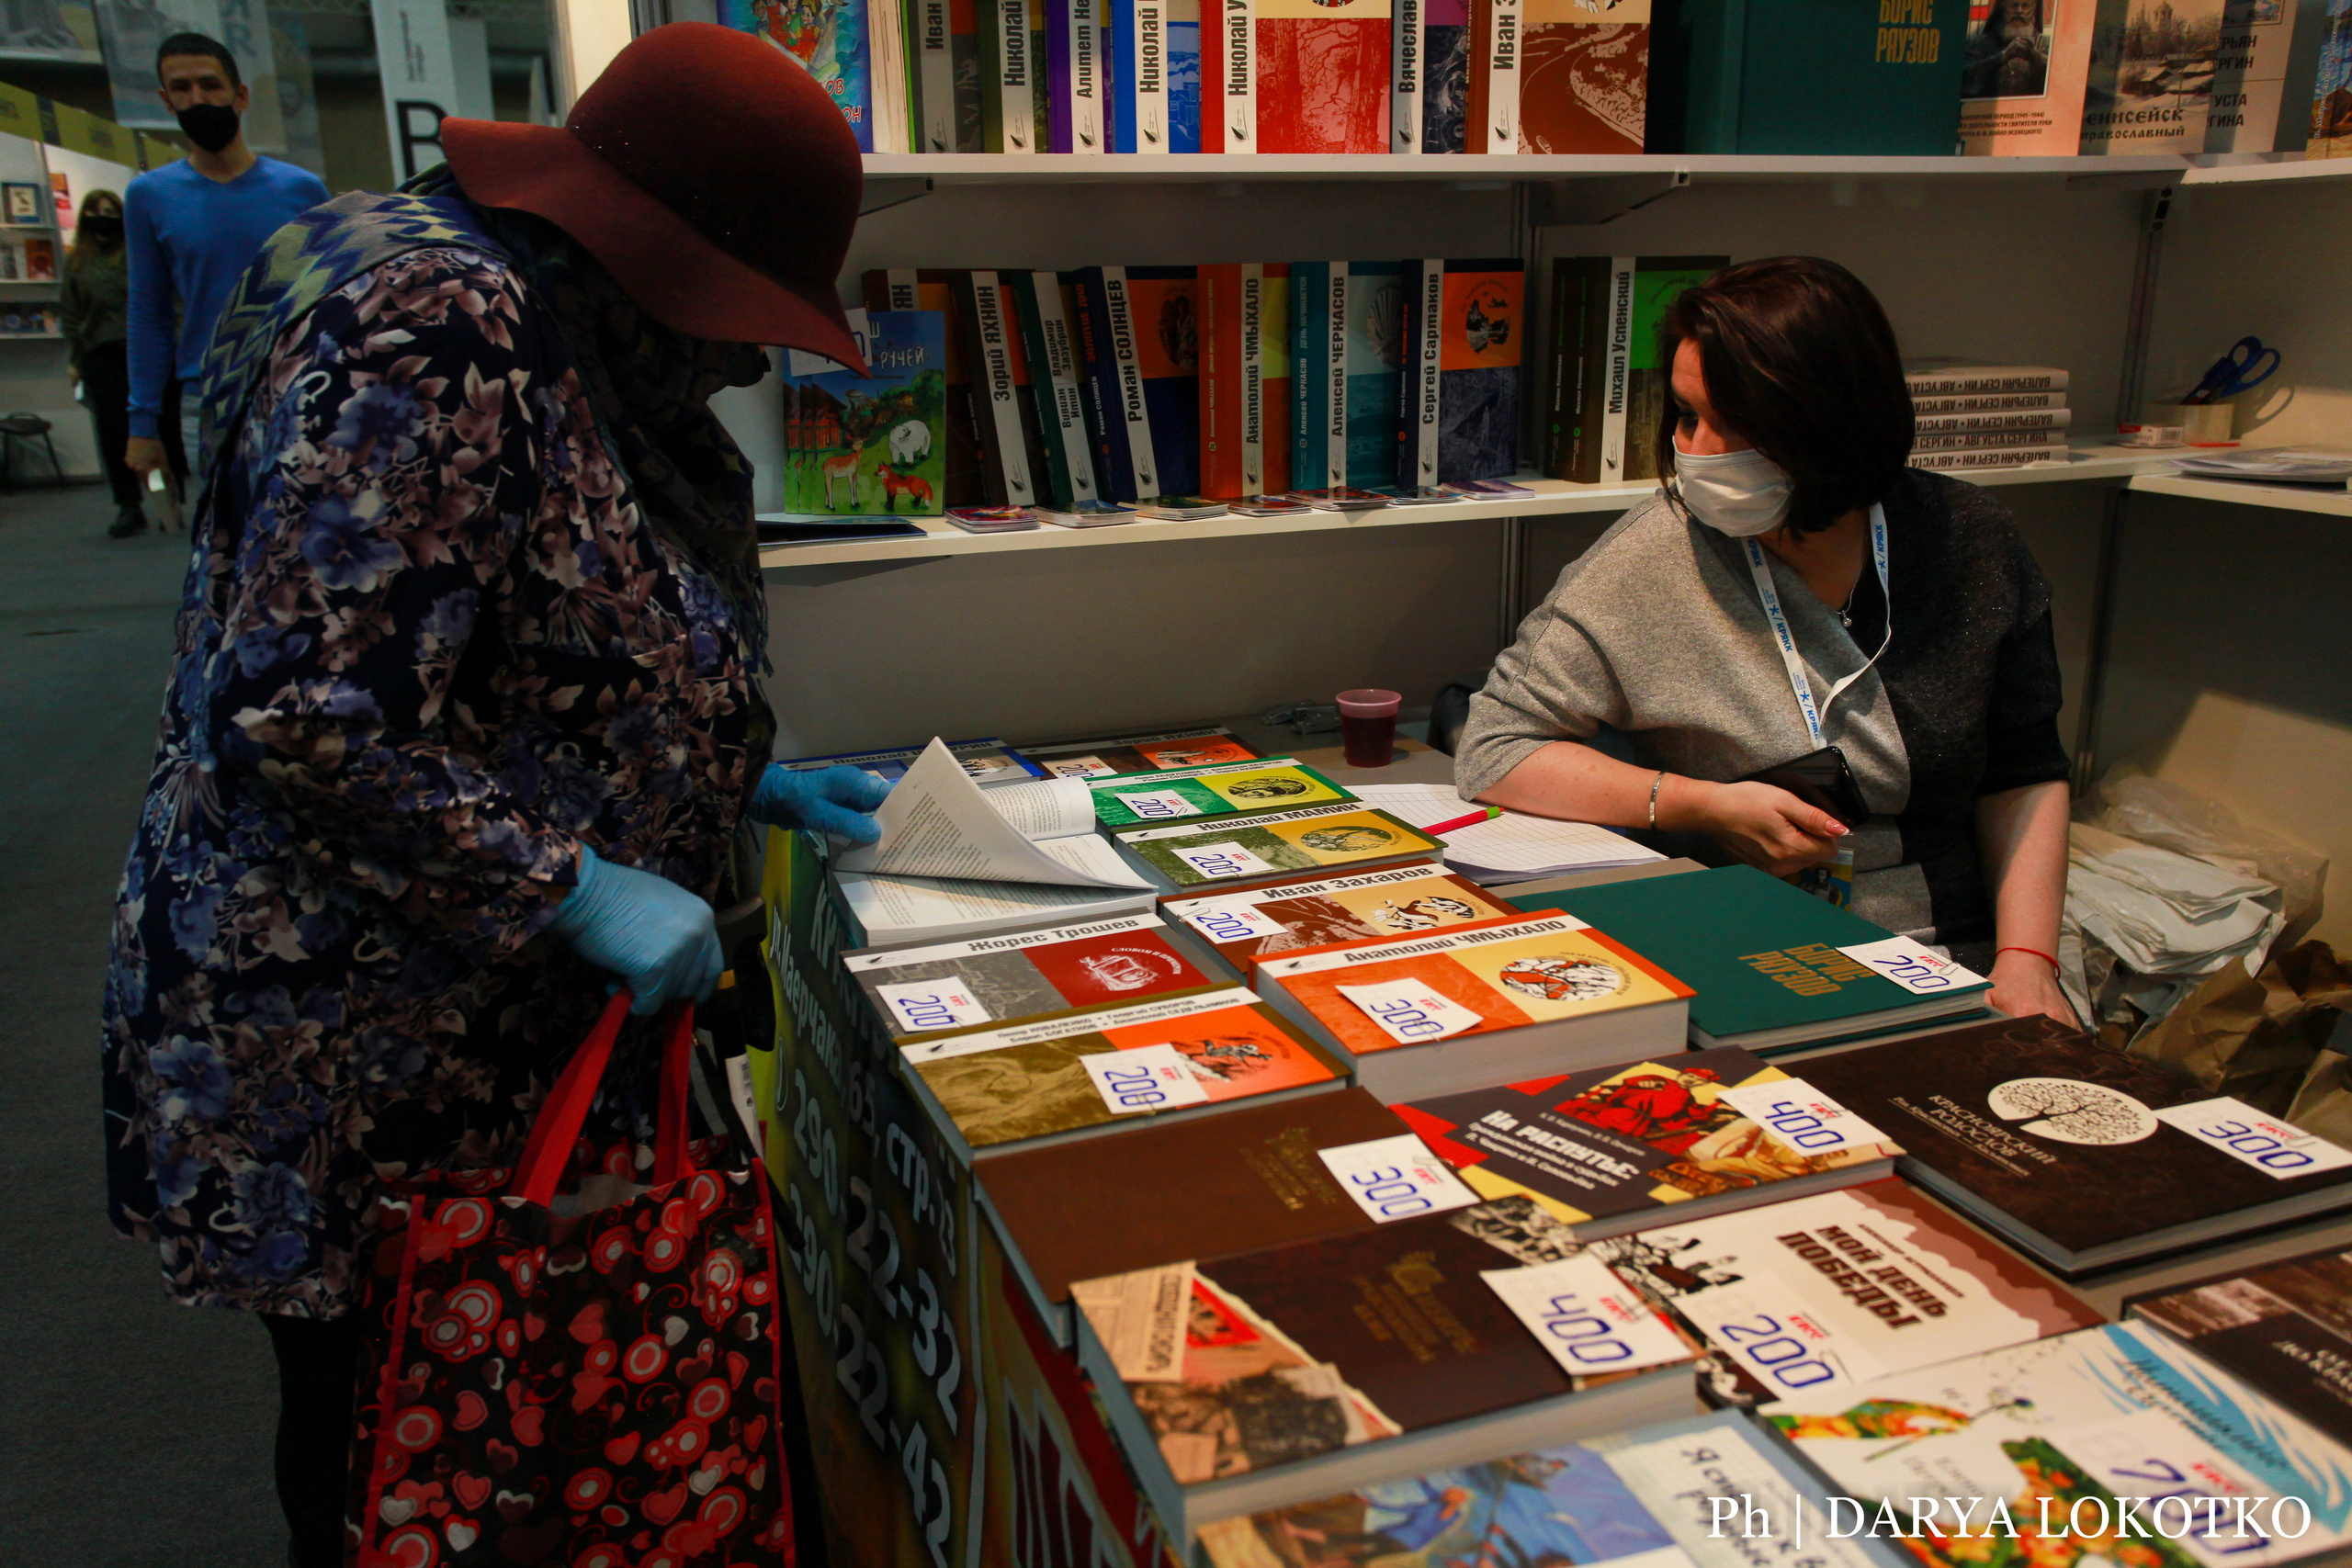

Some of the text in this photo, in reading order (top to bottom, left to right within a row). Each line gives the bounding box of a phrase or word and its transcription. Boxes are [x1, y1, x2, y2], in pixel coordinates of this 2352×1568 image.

[926, 3, 944, 50] Иван
[1001, 0, 1025, 86] Николай
[1397, 0, 1417, 93] Вячеслав
[1492, 14, 1516, 70] Иван
[1876, 28, 1939, 64] РЯУЗОВ
[1076, 25, 1092, 98] Алитет
[1138, 8, 1159, 93] Николай
[1227, 17, 1249, 96] Николай
[2086, 107, 2184, 126] ЕНИСЕЙСК
[977, 286, 1010, 401] Зорий ЯХНИН
[1044, 320, 1062, 377] Владимир
[1055, 319, 1072, 371] Зазубрин
[1106, 279, 1143, 423] Роман СОЛНЦЕВ
[1245, 278, 1259, 444] Анатолий ЧМЫХАЛО
[1332, 276, 1345, 436] Алексей ЧЕРКАСОВ
[1422, 273, 1440, 424] Сергей Сартаков
[1608, 271, 1630, 414] Михаил Успенский
[1068, 388, 1080, 418] Итин
[1964, 378, 2000, 390] СЕРГИН
[1964, 397, 1999, 410] СЕРГИН
[2001, 395, 2049, 409] ВАЛЕРЬЯН
[2002, 377, 2051, 389] ВАЛЕРЬЯН
[1057, 389, 1072, 428] Вивиан
[1966, 416, 2002, 429] СЕРГИН
[2004, 414, 2052, 427] ВАЛЕРЬЯН
[1964, 434, 2005, 446] АВГУСТА
[2007, 432, 2047, 444] СЕРГИНА
[1776, 622, 1793, 652] КРЯКК
[1131, 795, 1174, 818] 200
[1196, 802, 1362, 832] Николай МАМИН
[1188, 852, 1242, 877] 200
[1261, 866, 1434, 900] Иван Захаров
[967, 919, 1139, 953] Жорес Трошев
[1195, 911, 1254, 940] 200
[1343, 919, 1568, 963] Анатолий ЧМЫХАЛО
[1737, 951, 1842, 997] РЯУЗОВ
[898, 994, 956, 1027] 200
[1370, 998, 1444, 1037] 300
[1104, 1066, 1167, 1107] 200
[1765, 1101, 1845, 1148] 400
[1928, 1094, 2059, 1165] КРАСНОЯРСКИЙ
[1929, 1108, 2018, 1157] РОДОСЛОВ
[2198, 1120, 2314, 1168] 300
[1351, 1167, 1432, 1216] 300
[1776, 1229, 1926, 1330] ПОБЕДЫ
[1815, 1224, 1951, 1319] МОЙ ДЕНЬ
[1540, 1292, 1634, 1365] 400
[1720, 1314, 1836, 1389] 200
